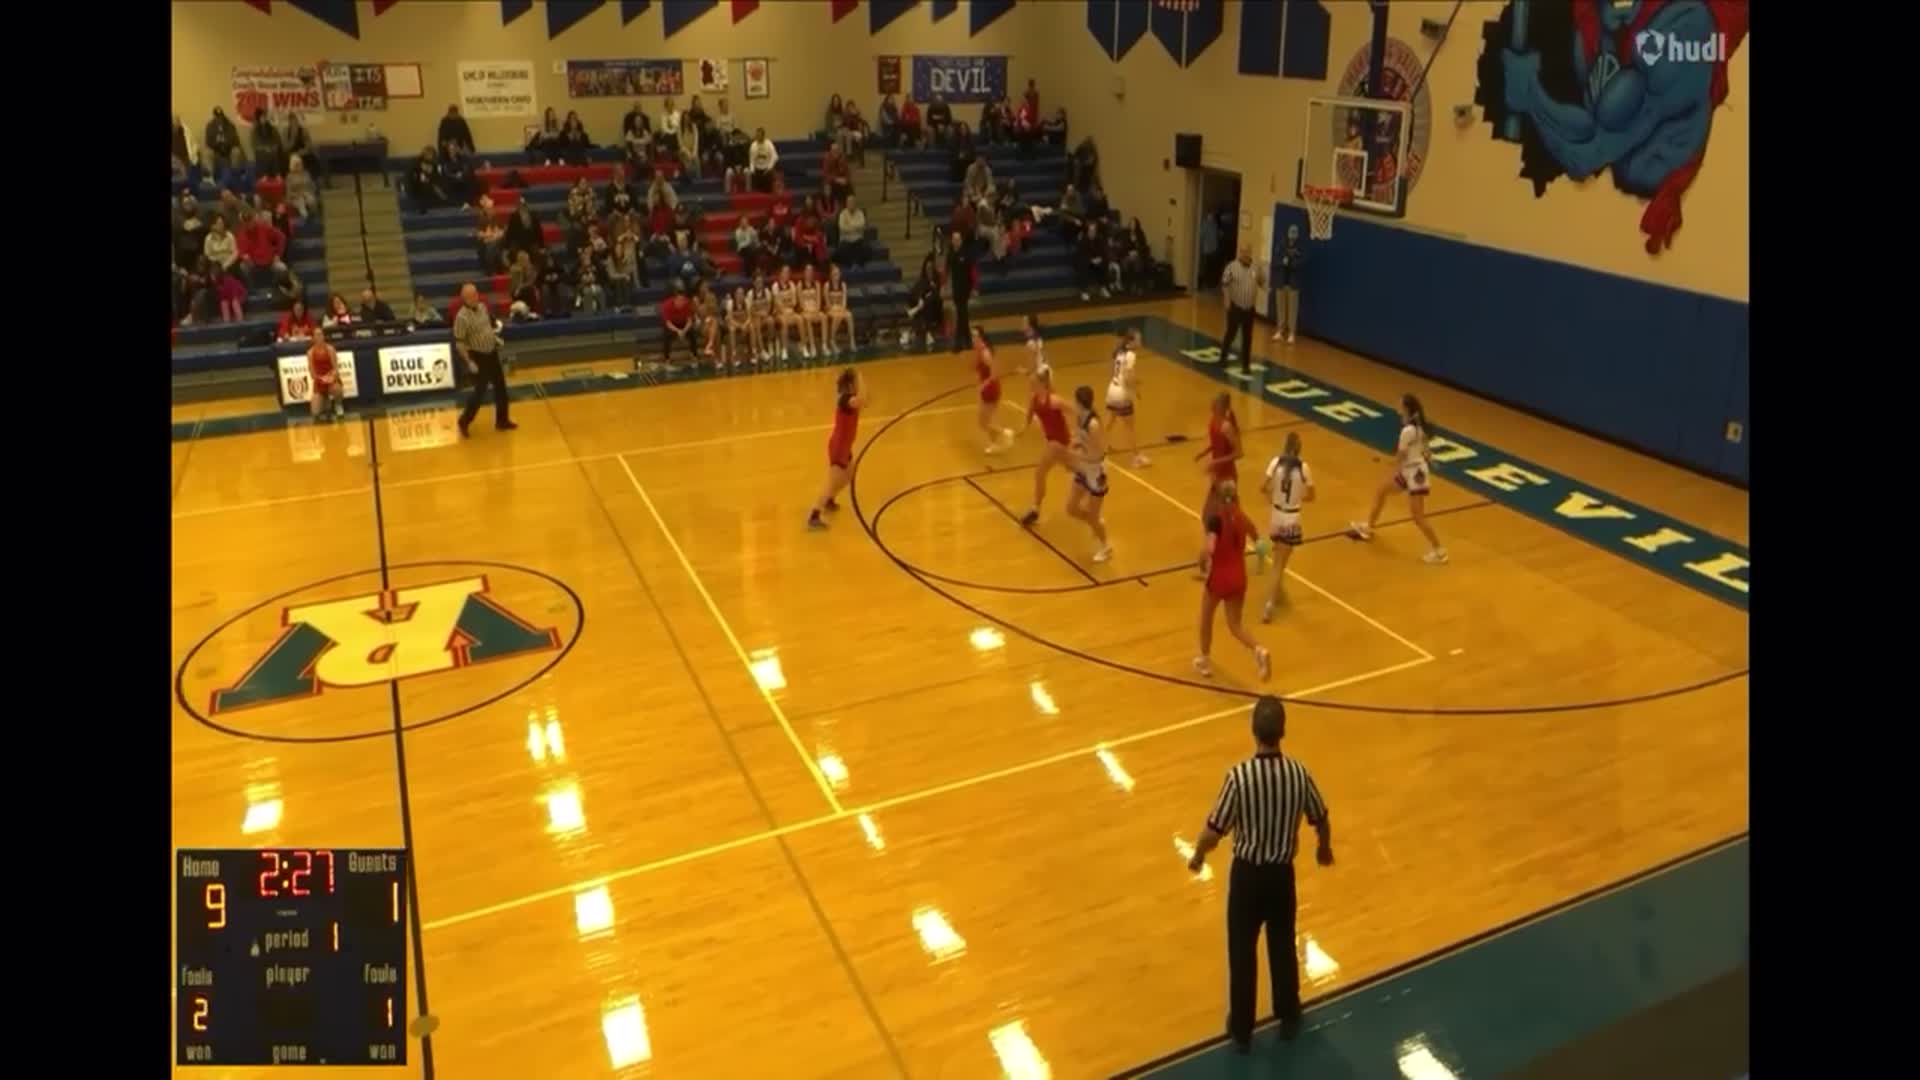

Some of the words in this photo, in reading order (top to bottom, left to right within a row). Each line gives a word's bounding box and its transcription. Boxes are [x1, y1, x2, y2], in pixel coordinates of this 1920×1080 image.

[931, 67, 991, 93] DEVIL
[273, 91, 320, 107] WINS
[390, 357, 424, 371] BLUE
[387, 372, 432, 387] DEVILS
